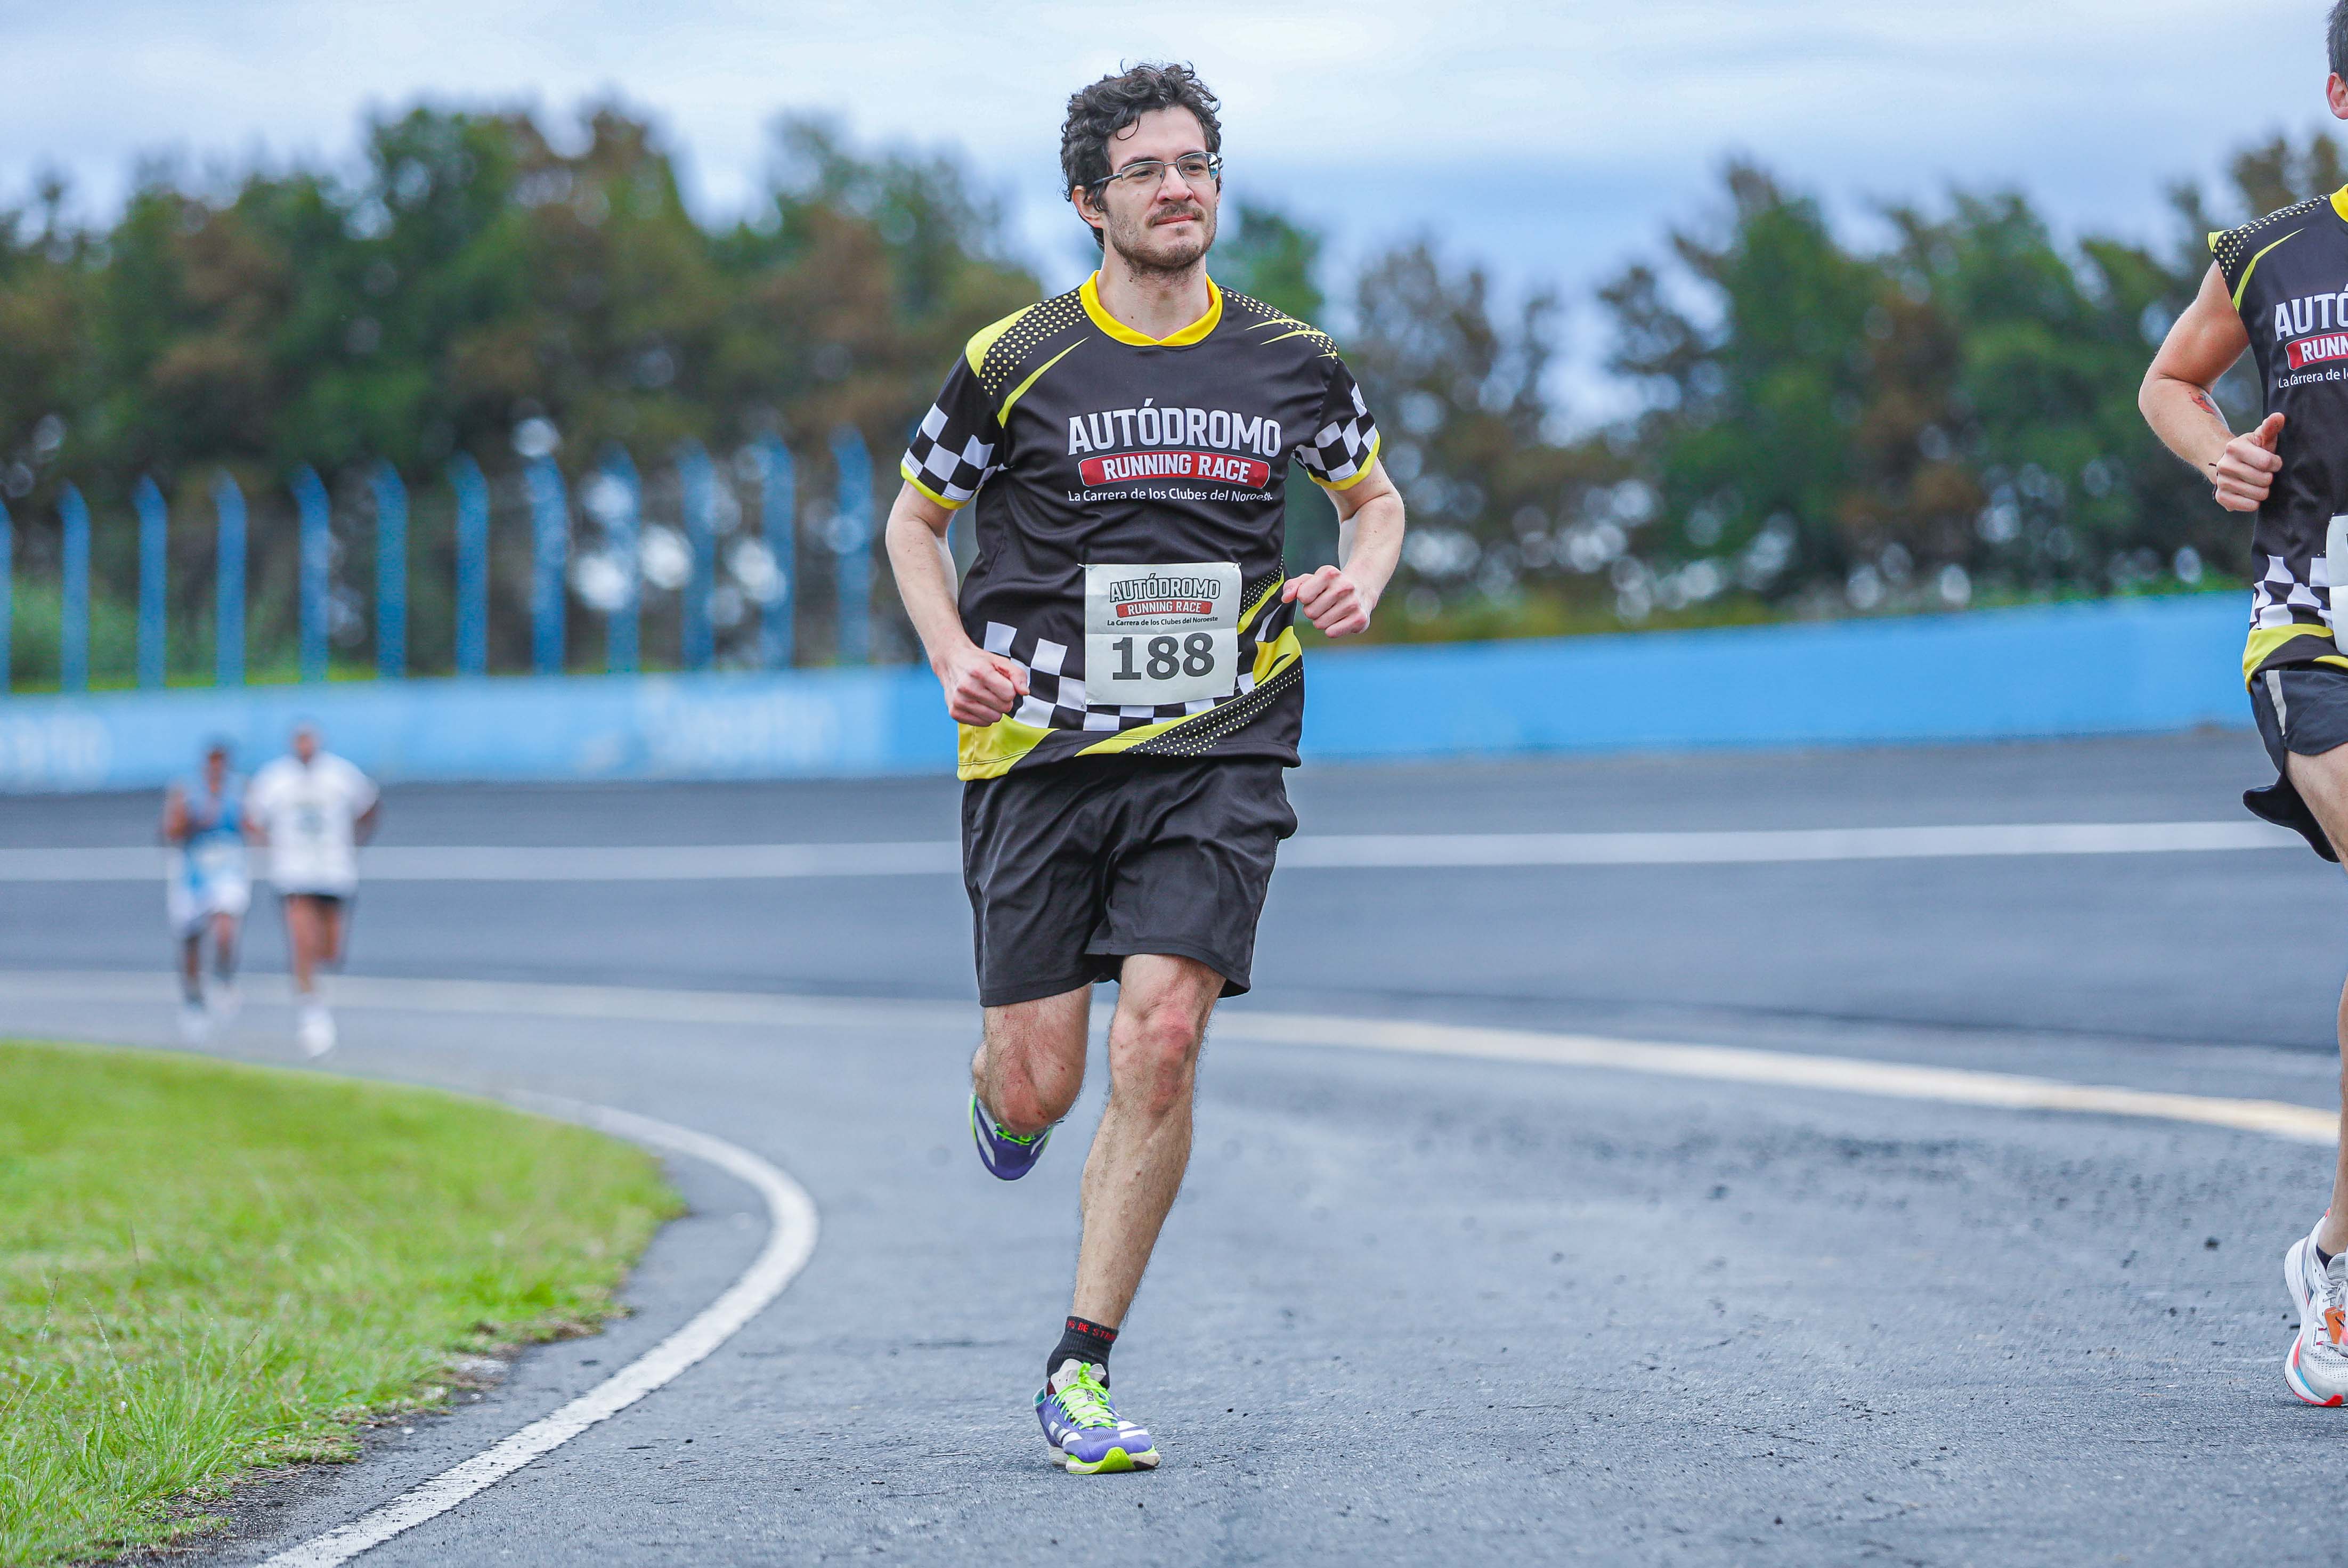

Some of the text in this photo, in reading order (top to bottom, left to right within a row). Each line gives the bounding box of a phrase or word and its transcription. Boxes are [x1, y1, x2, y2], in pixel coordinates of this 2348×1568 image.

[2278, 377, 2289, 388] La
[2290, 373, 2323, 385] Carrera
[2326, 369, 2340, 380] de
[1068, 397, 1281, 457] AUTÓDROMO
[1102, 454, 1252, 483] RUNNING RACE
[1068, 490, 1080, 502] La
[1083, 490, 1127, 501] Carrera
[1131, 488, 1146, 499] de
[1149, 488, 1166, 500] los
[1168, 488, 1207, 500] Clubes
[1210, 489, 1229, 501] del
[1109, 573, 1221, 603] AUTÓDROMO
[1127, 602, 1201, 615] RUNNING RACE
[1112, 632, 1215, 680] 188
